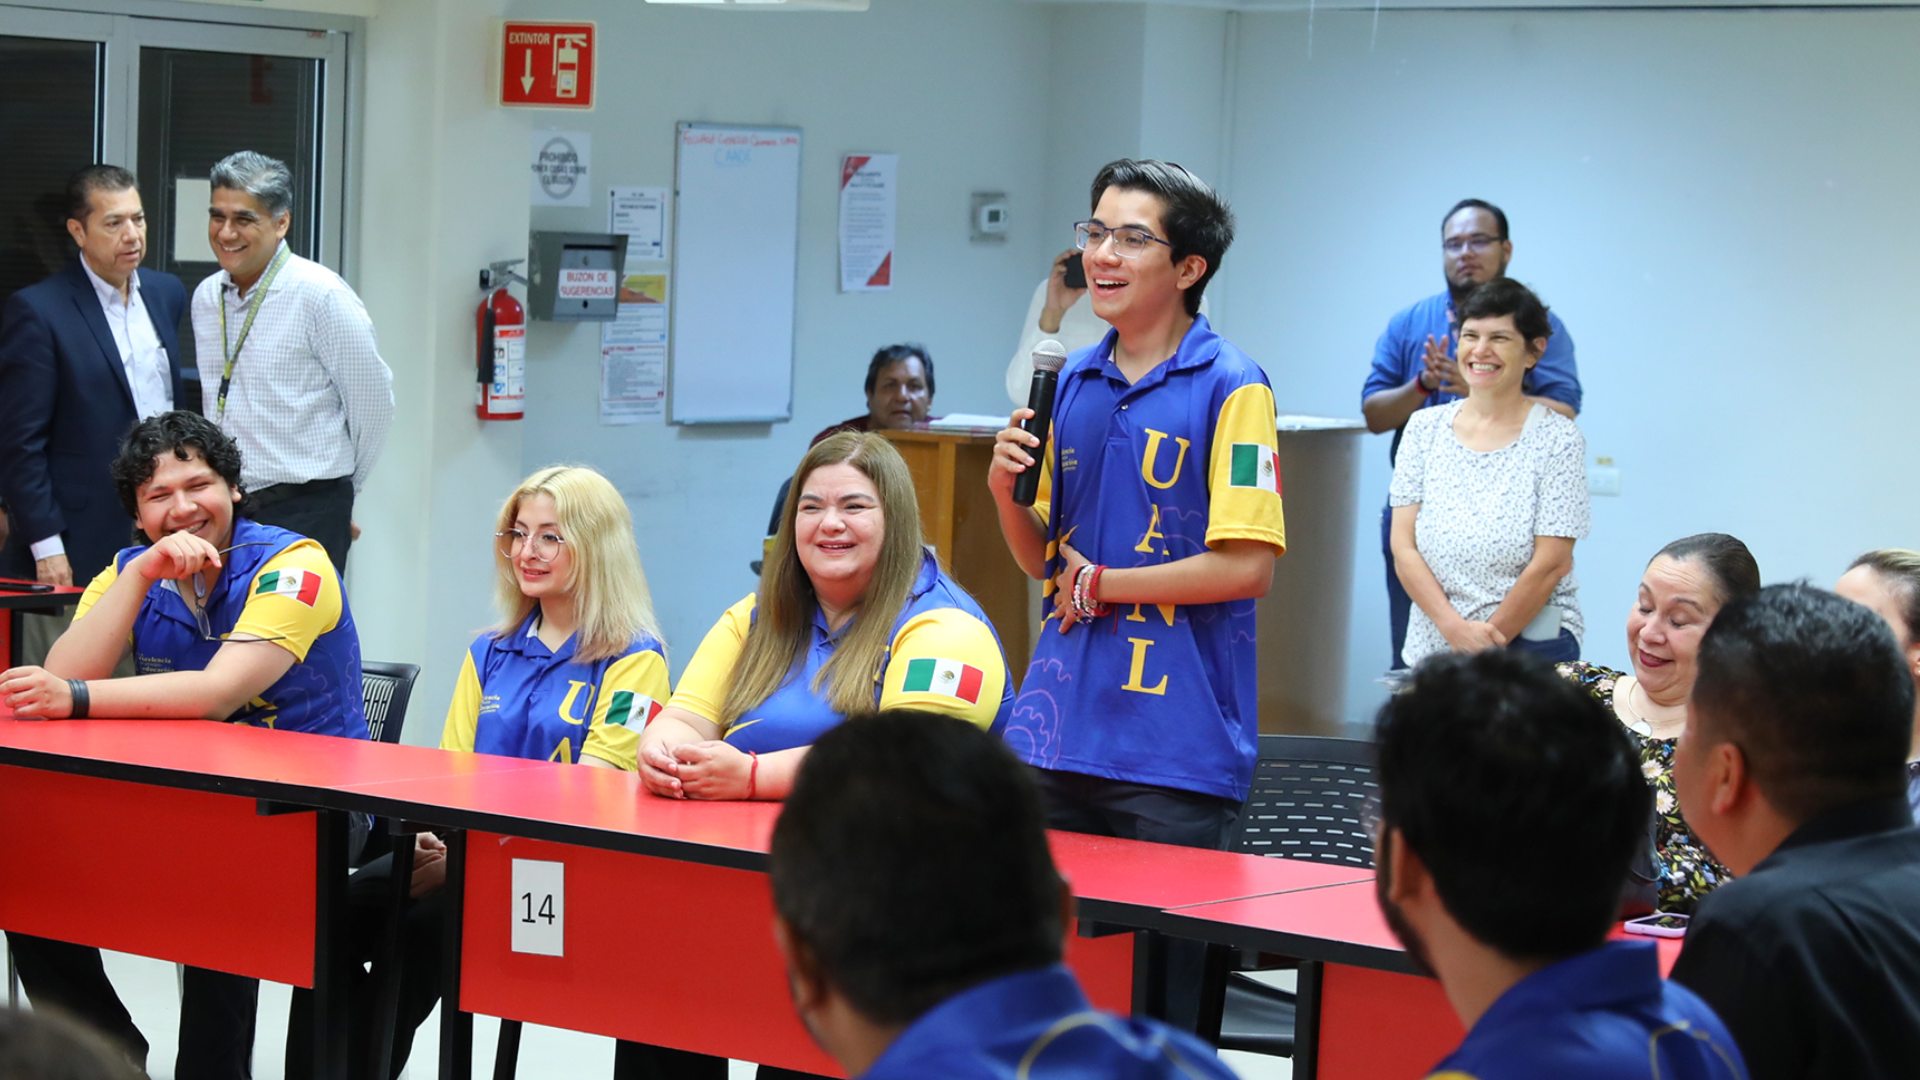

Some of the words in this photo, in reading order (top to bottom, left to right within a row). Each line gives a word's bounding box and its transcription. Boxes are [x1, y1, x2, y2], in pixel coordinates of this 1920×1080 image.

[509, 32, 550, 45] EXTINTOR
[597, 271, 609, 282] DE
[561, 285, 614, 297] SUGERENCIAS
[522, 892, 555, 925] 14
